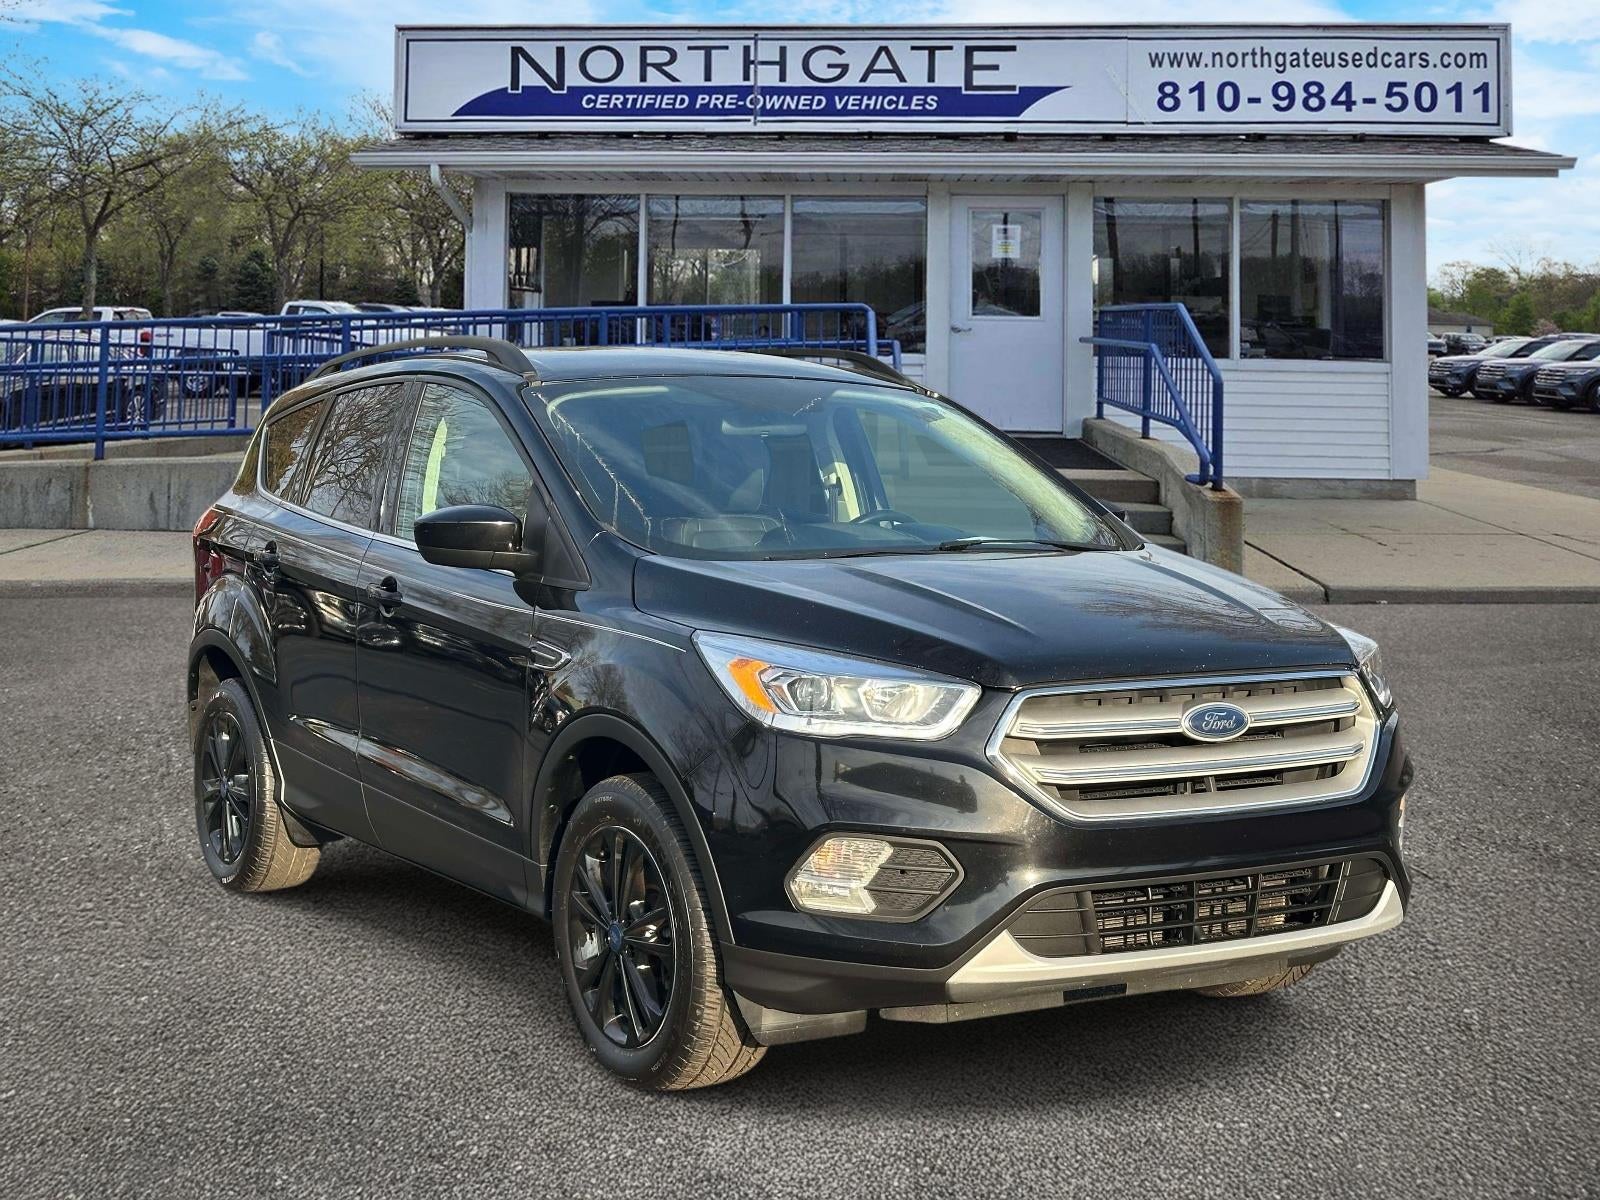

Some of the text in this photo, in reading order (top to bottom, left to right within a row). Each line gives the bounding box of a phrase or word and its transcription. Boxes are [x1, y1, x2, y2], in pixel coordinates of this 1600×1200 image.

[510, 45, 1017, 92] NORTHGATE
[1148, 46, 1488, 74] www.northgateusedcars.com
[581, 94, 939, 111] CERTIFIED PRE-OWNED VEHICLES
[1156, 80, 1493, 114] 810-984-5011
[1202, 711, 1236, 731] Ford
